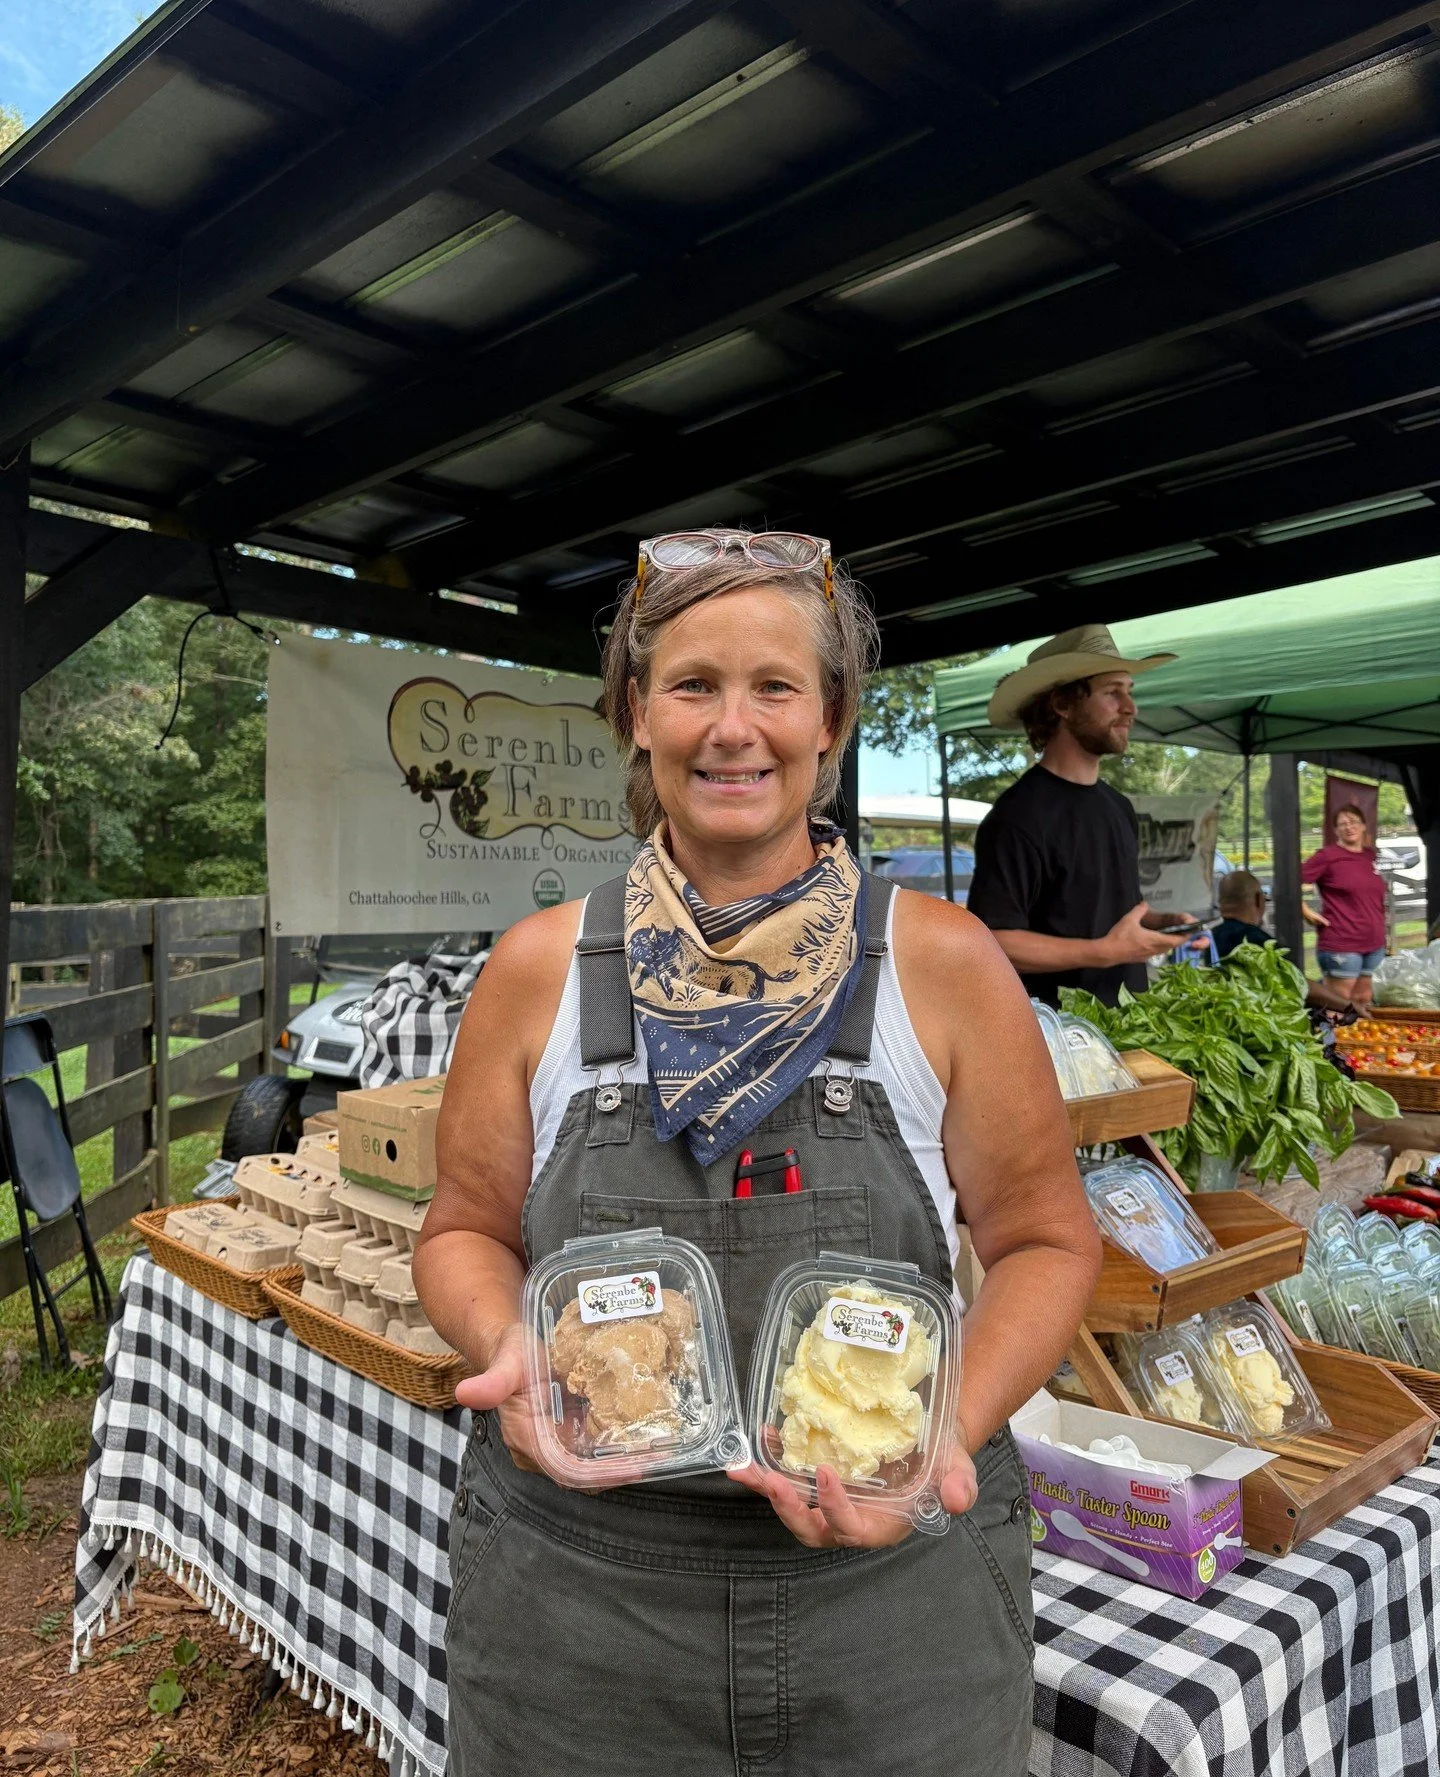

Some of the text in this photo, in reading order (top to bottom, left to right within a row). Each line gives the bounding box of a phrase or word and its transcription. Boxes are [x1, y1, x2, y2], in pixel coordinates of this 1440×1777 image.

[420, 699, 606, 769] Serenbe
[501, 763, 631, 823] Farms
[426, 839, 633, 864] SUSTAINABLE ORGANICS
[348, 890, 491, 907] Chattahoochee Hills, GA
[591, 1285, 637, 1301] Serenbe
[610, 1296, 645, 1308] Farms
[838, 1307, 884, 1327] Serenbe
[853, 1321, 889, 1339] Farms
[1031, 1471, 1075, 1504] Plastic
[1076, 1488, 1120, 1519] Taster
[1122, 1501, 1171, 1530] Spoon
